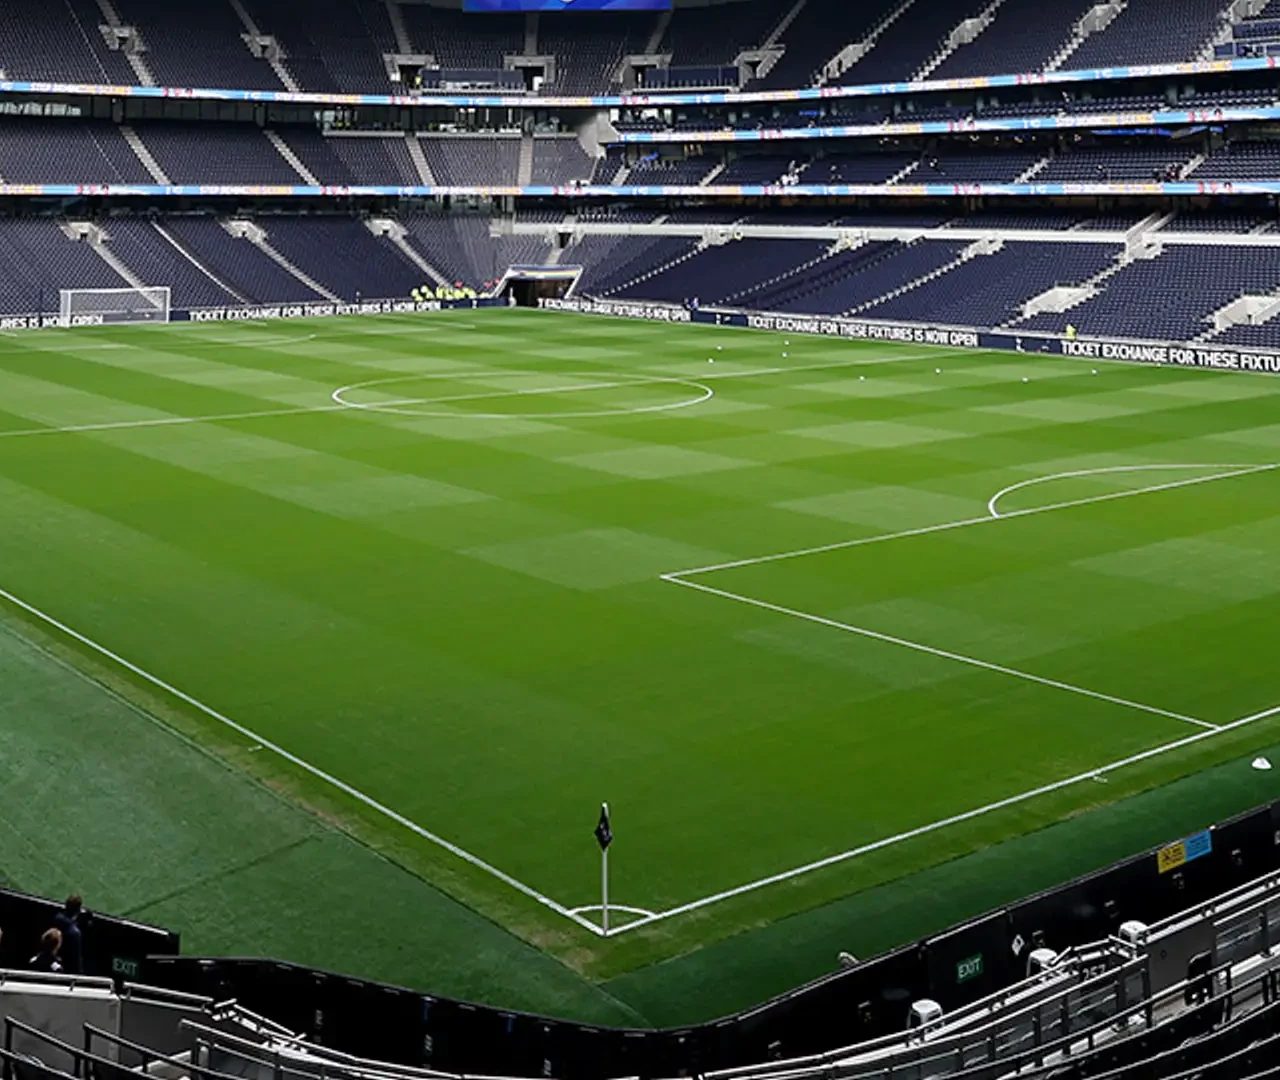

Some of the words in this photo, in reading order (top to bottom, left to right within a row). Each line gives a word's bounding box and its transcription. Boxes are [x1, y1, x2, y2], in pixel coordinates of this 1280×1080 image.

[227, 307, 280, 320] EXCHANGE
[283, 306, 302, 317] FOR
[304, 305, 333, 316] THESE
[336, 304, 381, 315] FIXTURES
[394, 302, 415, 312] NOW
[417, 301, 441, 311] OPEN
[29, 316, 39, 328] IS
[72, 315, 103, 325] OPEN
[776, 317, 818, 334] EXCHANGE
[820, 320, 839, 334] FOR
[840, 321, 868, 337] THESE
[869, 324, 913, 341] FIXTURES
[914, 328, 923, 342] IS
[926, 328, 948, 344] NOW
[950, 332, 978, 347] OPEN
[1060, 340, 1101, 358] TICKET
[1102, 344, 1167, 363] EXCHANGE
[1170, 348, 1194, 364] FOR
[1196, 350, 1239, 368] THESE
[112, 958, 138, 976] EXIT
[958, 958, 981, 978] EXIT
